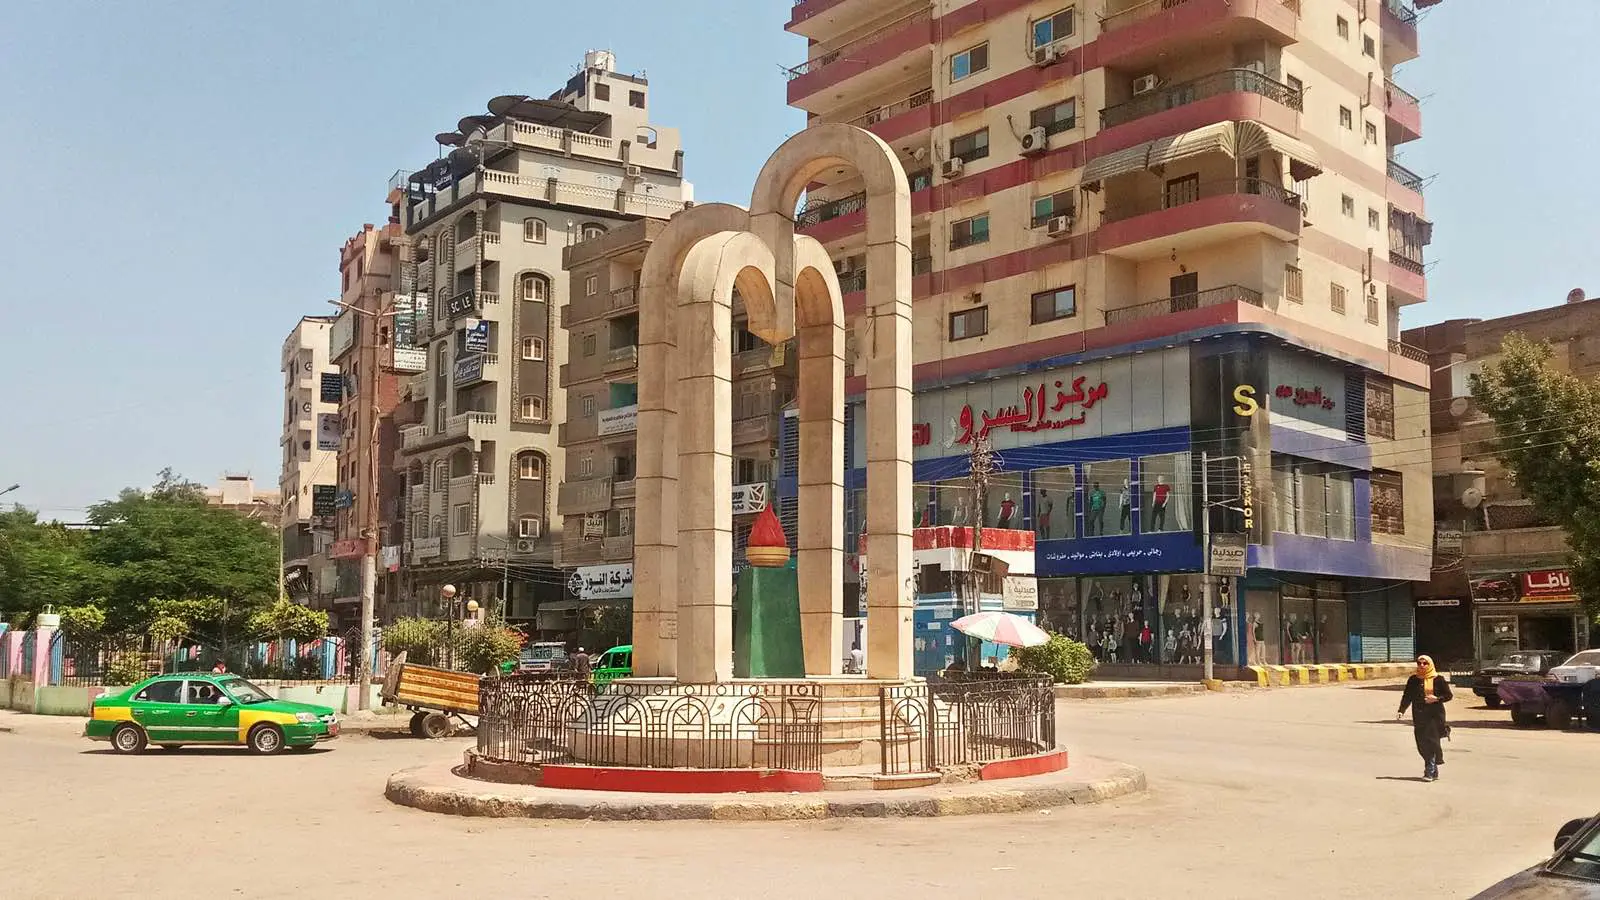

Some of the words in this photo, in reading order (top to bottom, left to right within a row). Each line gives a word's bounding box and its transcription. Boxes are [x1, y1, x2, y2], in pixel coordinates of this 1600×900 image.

[1051, 376, 1108, 412] مركز
[1232, 384, 1259, 417] S
[942, 383, 1046, 449] السرور
[1213, 548, 1244, 558] صيدلية
[610, 569, 633, 588] شركة
[1527, 572, 1571, 591] باظا
